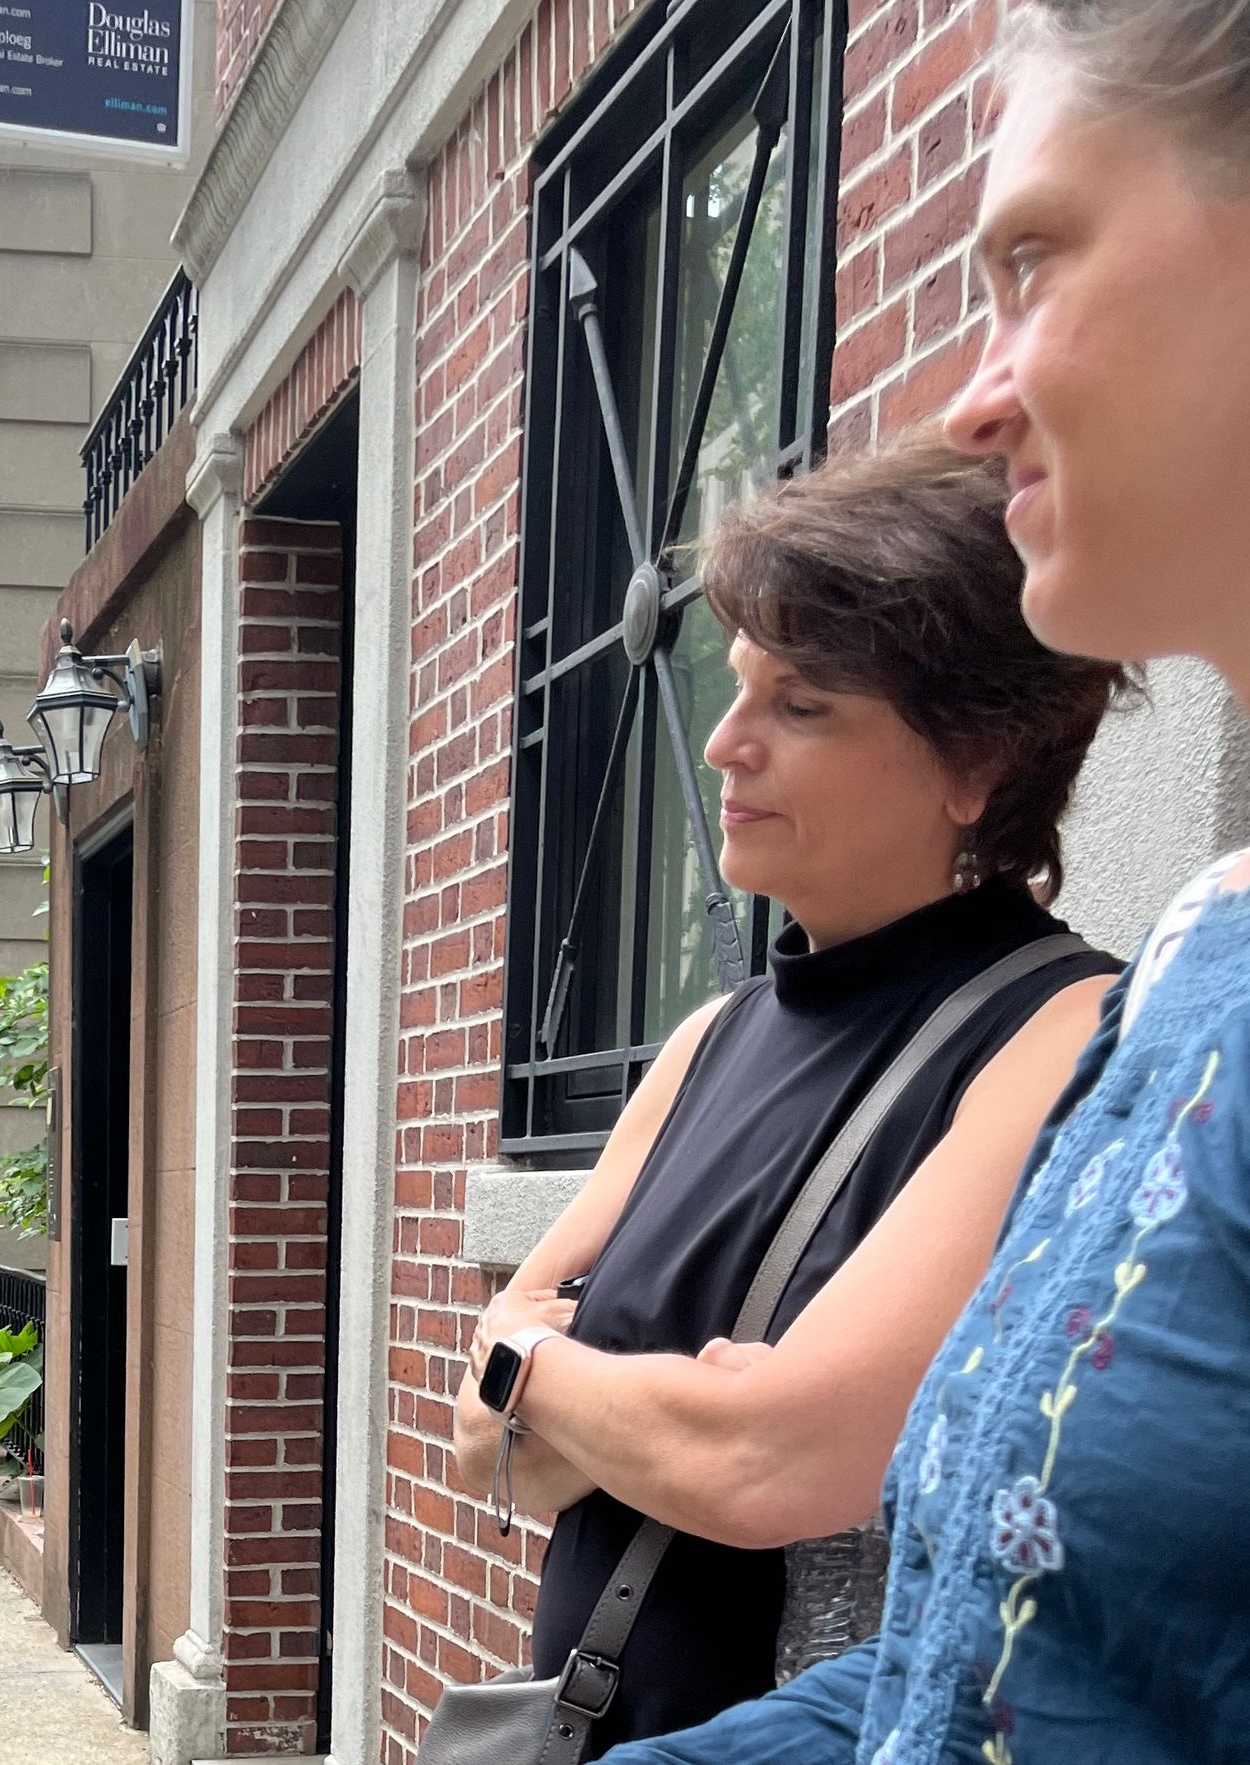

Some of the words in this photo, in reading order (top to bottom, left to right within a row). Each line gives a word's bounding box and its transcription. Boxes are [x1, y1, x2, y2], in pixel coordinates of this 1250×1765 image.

[88, 2, 170, 41] Douglas
[88, 29, 169, 64] Elliman
[7, 50, 33, 63] Estate
[36, 54, 63, 67] Broker
[88, 56, 120, 69] REAL
[124, 61, 168, 76] ESTATE
[104, 97, 168, 115] elliman.com
